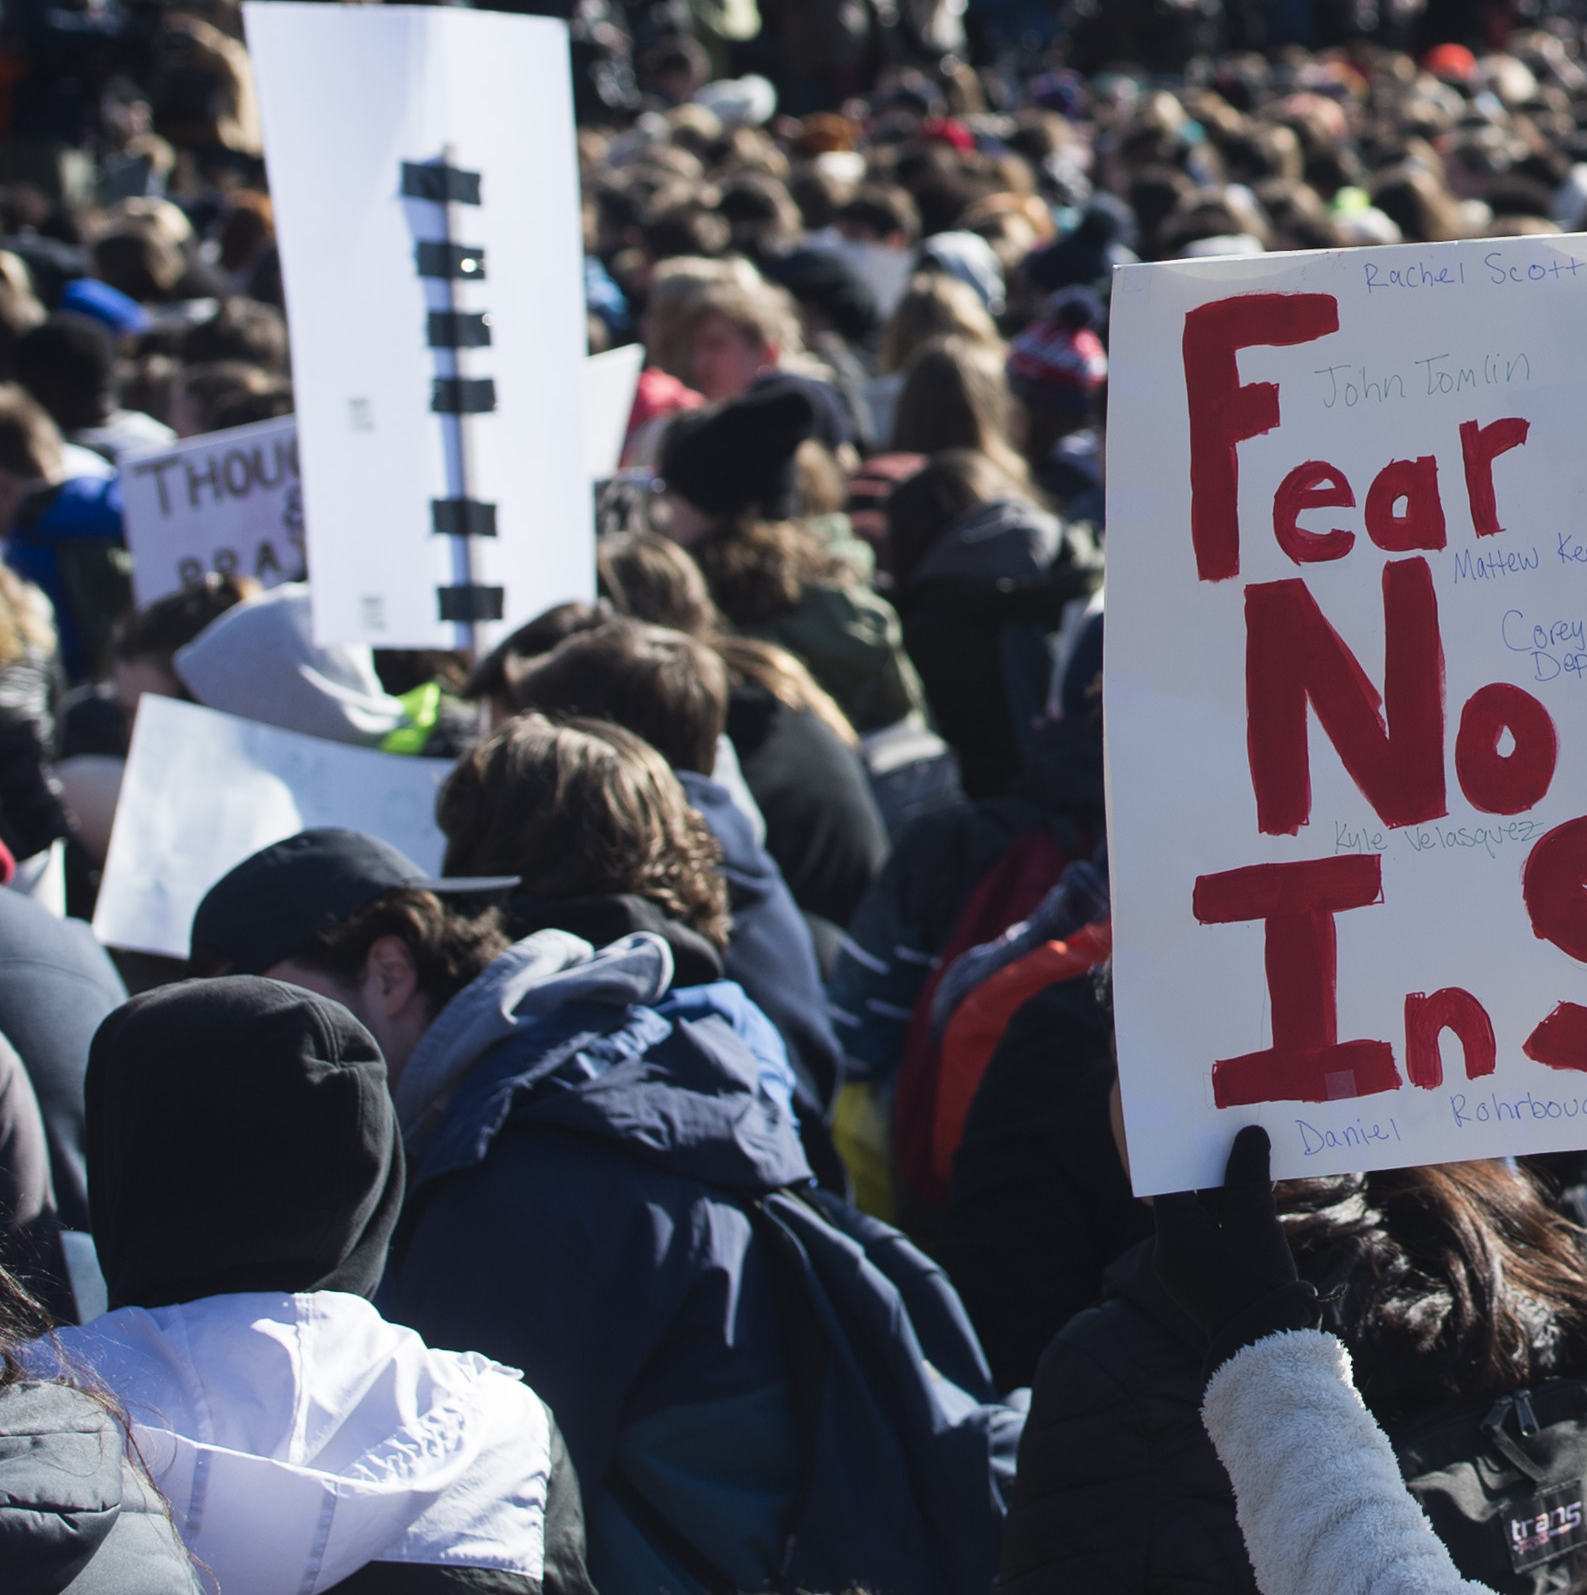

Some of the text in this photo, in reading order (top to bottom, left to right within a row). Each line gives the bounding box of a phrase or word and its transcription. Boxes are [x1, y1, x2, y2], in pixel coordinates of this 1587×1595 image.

[1363, 252, 1586, 293] Rachel Scott
[1314, 352, 1531, 409] John Tomlin
[1183, 293, 1530, 582] Fear
[1453, 547, 1539, 584] Mattew
[1501, 609, 1587, 652] Corey
[1244, 555, 1558, 836] No
[1334, 820, 1545, 860] Kyle Velasquez
[1193, 854, 1497, 1109] In
[1294, 1117, 1402, 1156] Daniel
[1511, 1501, 1582, 1542] trans
